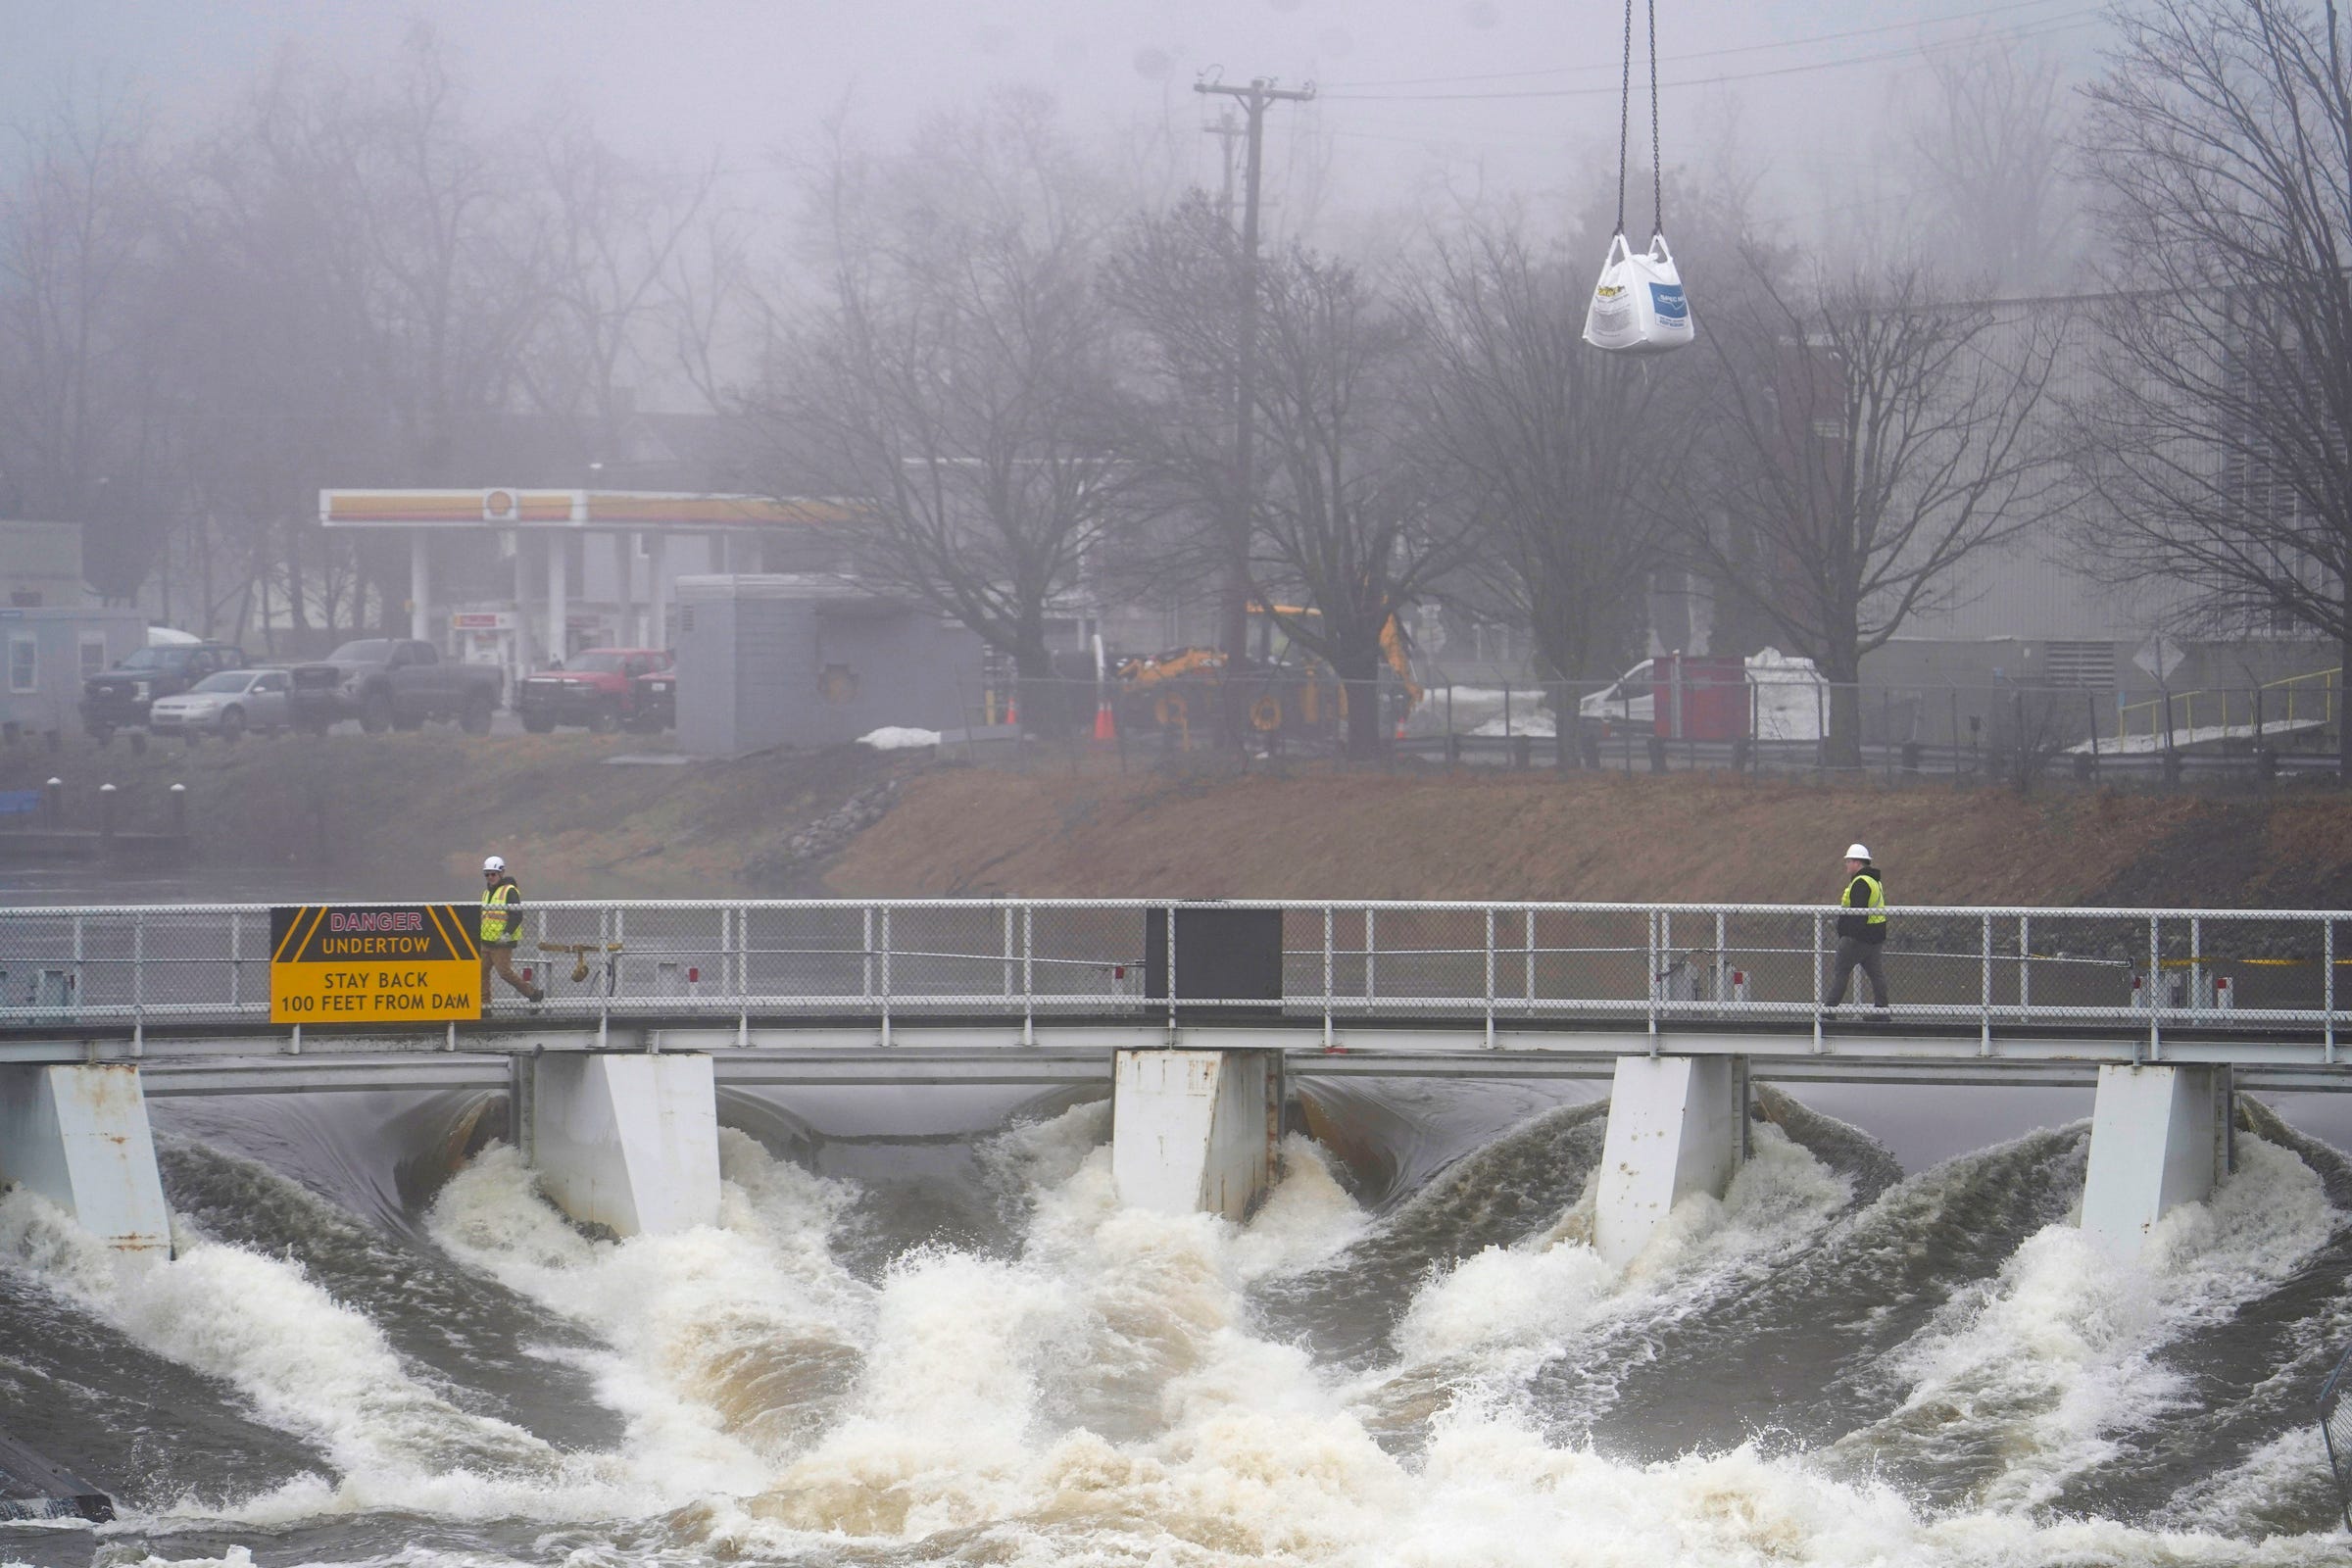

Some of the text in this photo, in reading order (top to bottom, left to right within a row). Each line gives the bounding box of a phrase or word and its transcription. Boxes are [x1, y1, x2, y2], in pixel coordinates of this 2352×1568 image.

[330, 912, 423, 931] DANGER
[322, 937, 430, 954] UNDERTOW
[324, 972, 428, 989] STAY BACK
[282, 994, 469, 1011] 100 FEET FROM DAM
